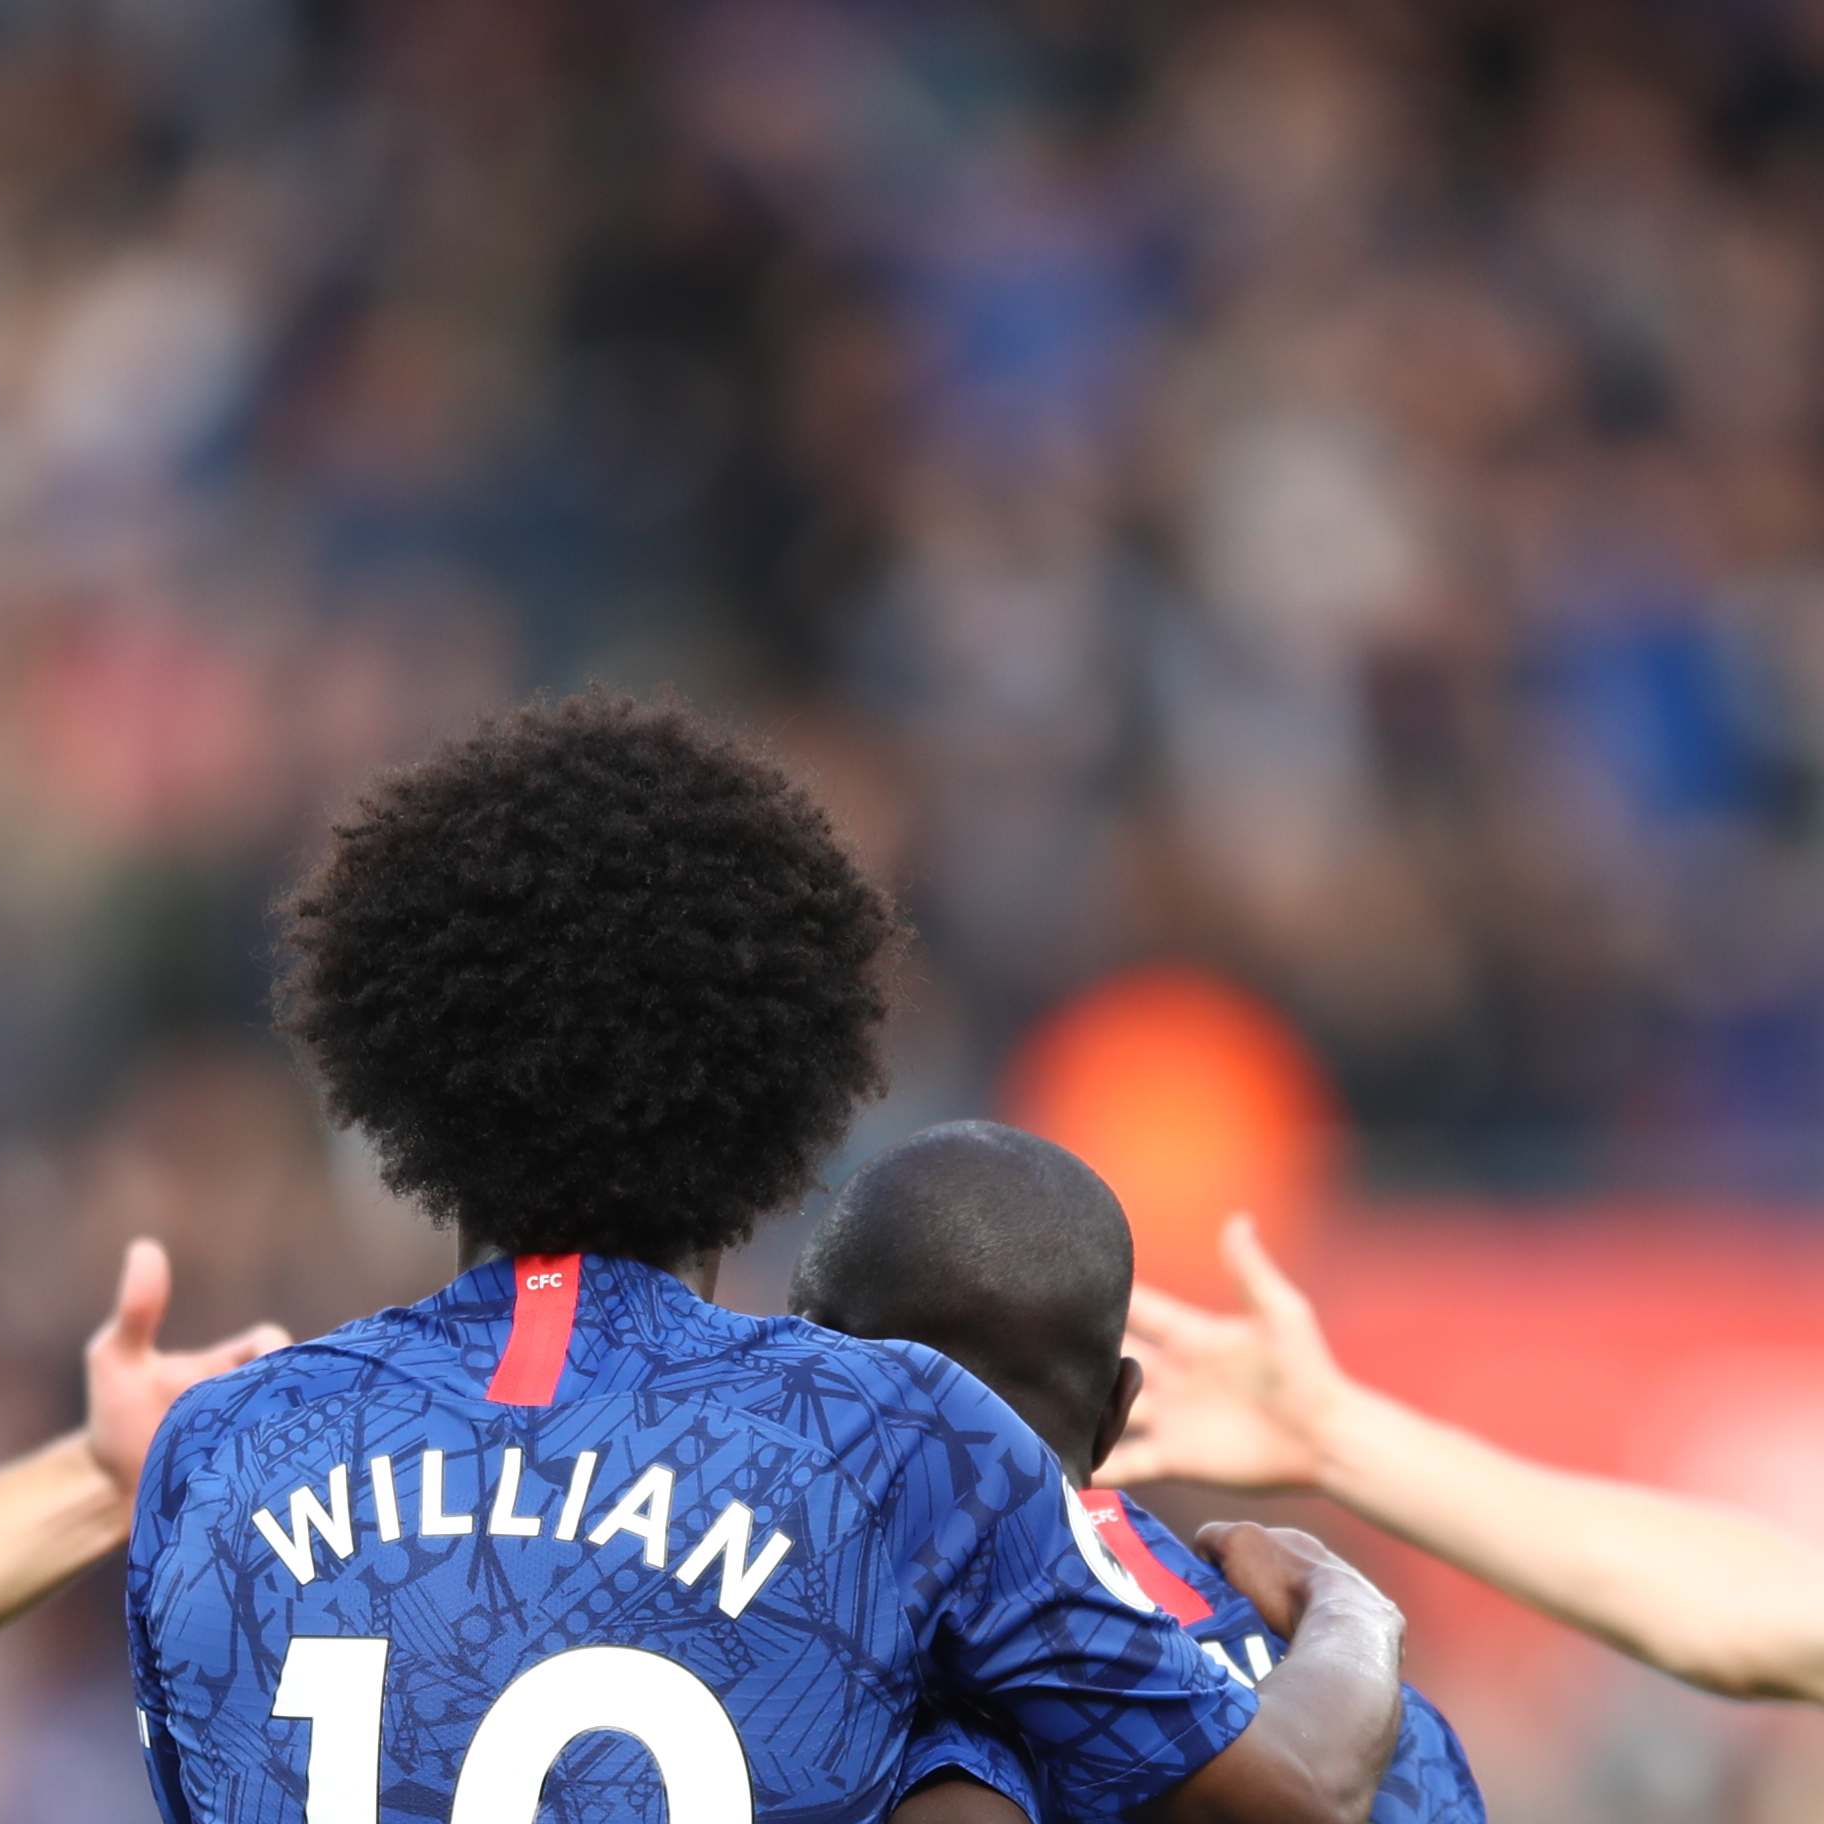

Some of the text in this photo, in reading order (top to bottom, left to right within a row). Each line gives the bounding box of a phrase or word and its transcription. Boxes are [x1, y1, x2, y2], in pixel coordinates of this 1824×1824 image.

[526, 1272, 563, 1291] CFC
[1089, 1508, 1119, 1526] CFC
[250, 1446, 793, 1620] WILLIAN
